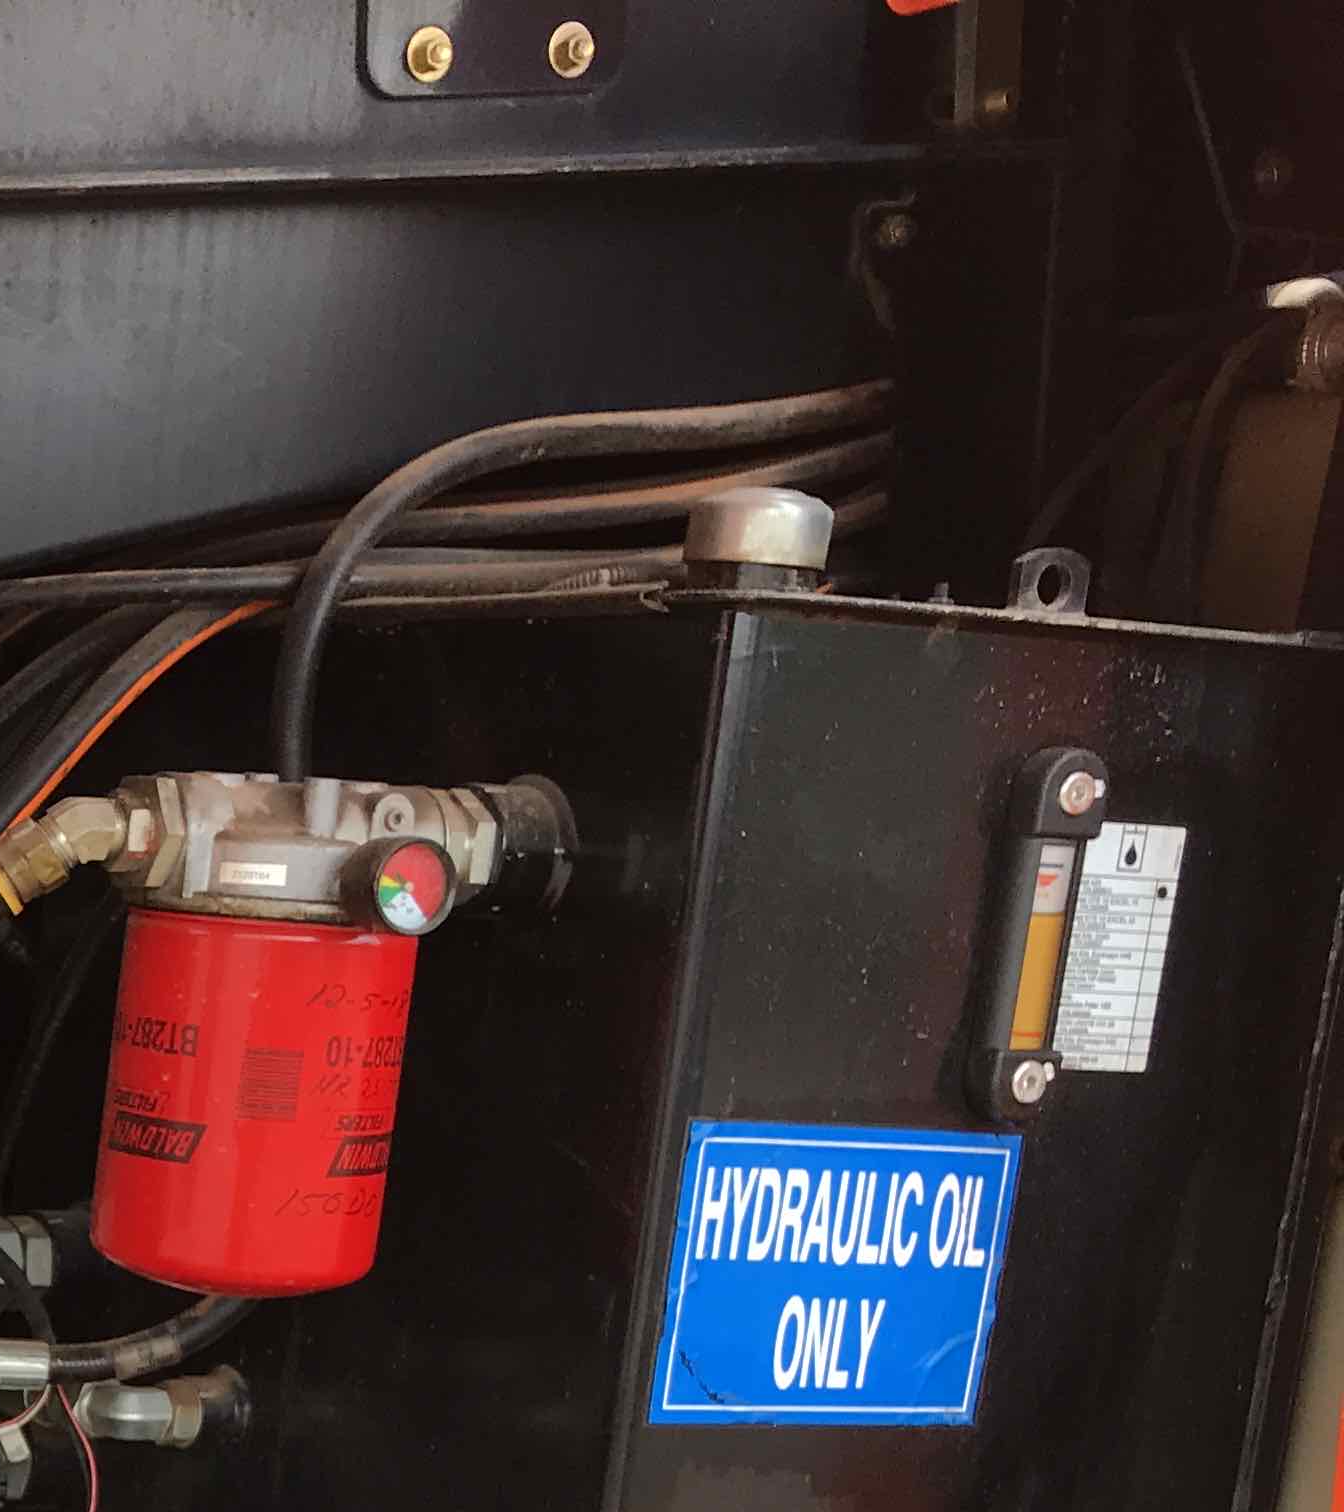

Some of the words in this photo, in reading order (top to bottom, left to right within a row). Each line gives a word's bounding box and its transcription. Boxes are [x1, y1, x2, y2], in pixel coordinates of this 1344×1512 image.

[695, 1166, 925, 1268] HYDRAULIC
[928, 1172, 986, 1269] OIL
[772, 1295, 887, 1391] ONLY
